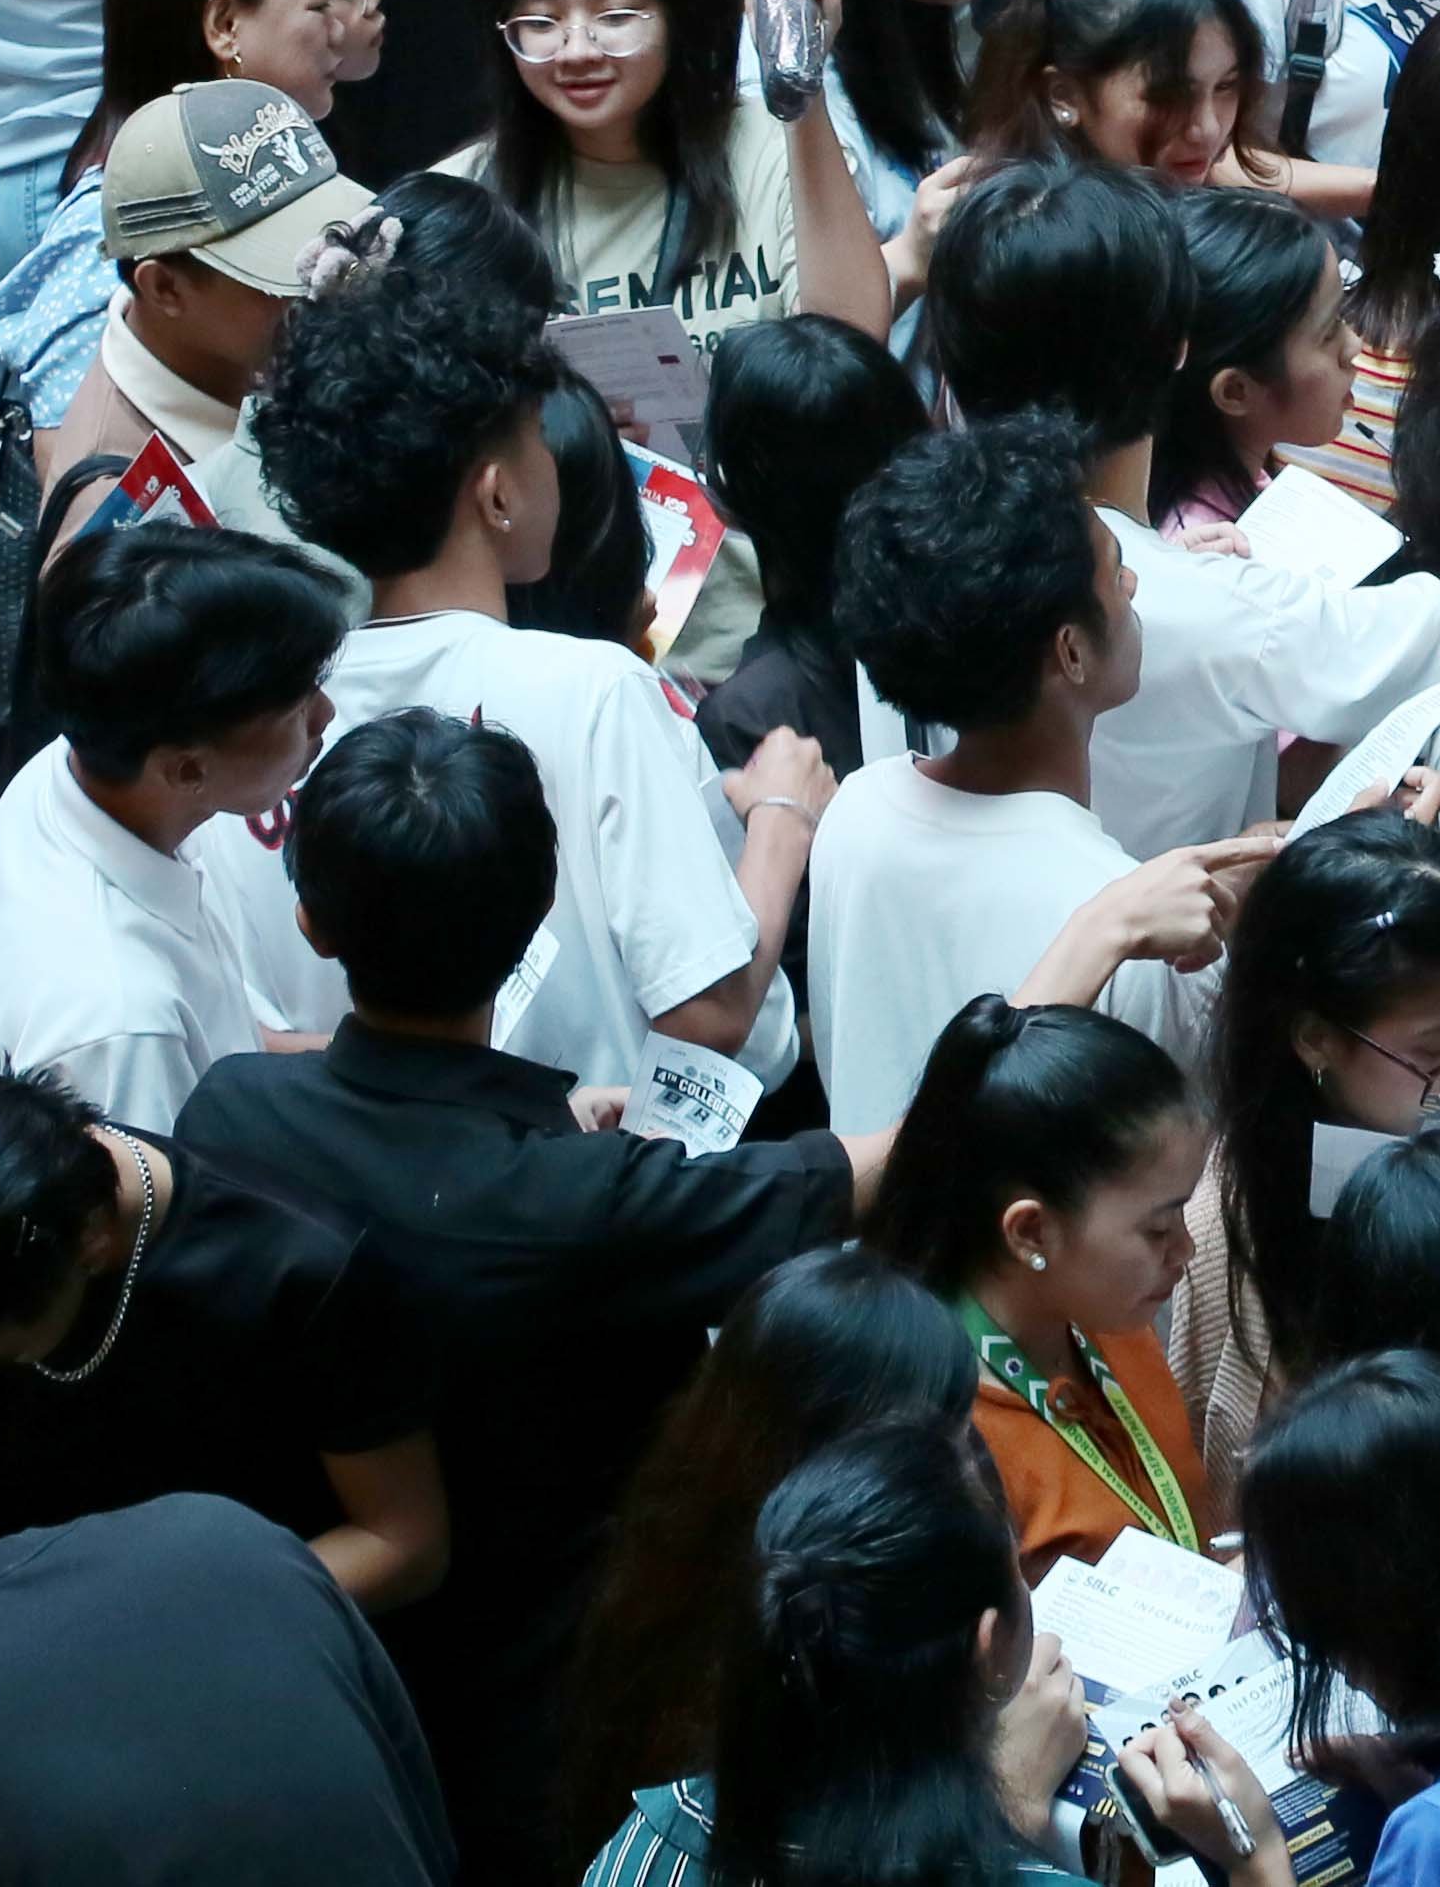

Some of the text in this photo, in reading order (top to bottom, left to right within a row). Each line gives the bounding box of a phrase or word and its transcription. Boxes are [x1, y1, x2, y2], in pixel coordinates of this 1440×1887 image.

[678, 1077, 727, 1115] COLLEGE
[1083, 1575, 1120, 1598] SBLC
[1171, 1669, 1205, 1691] SBLC
